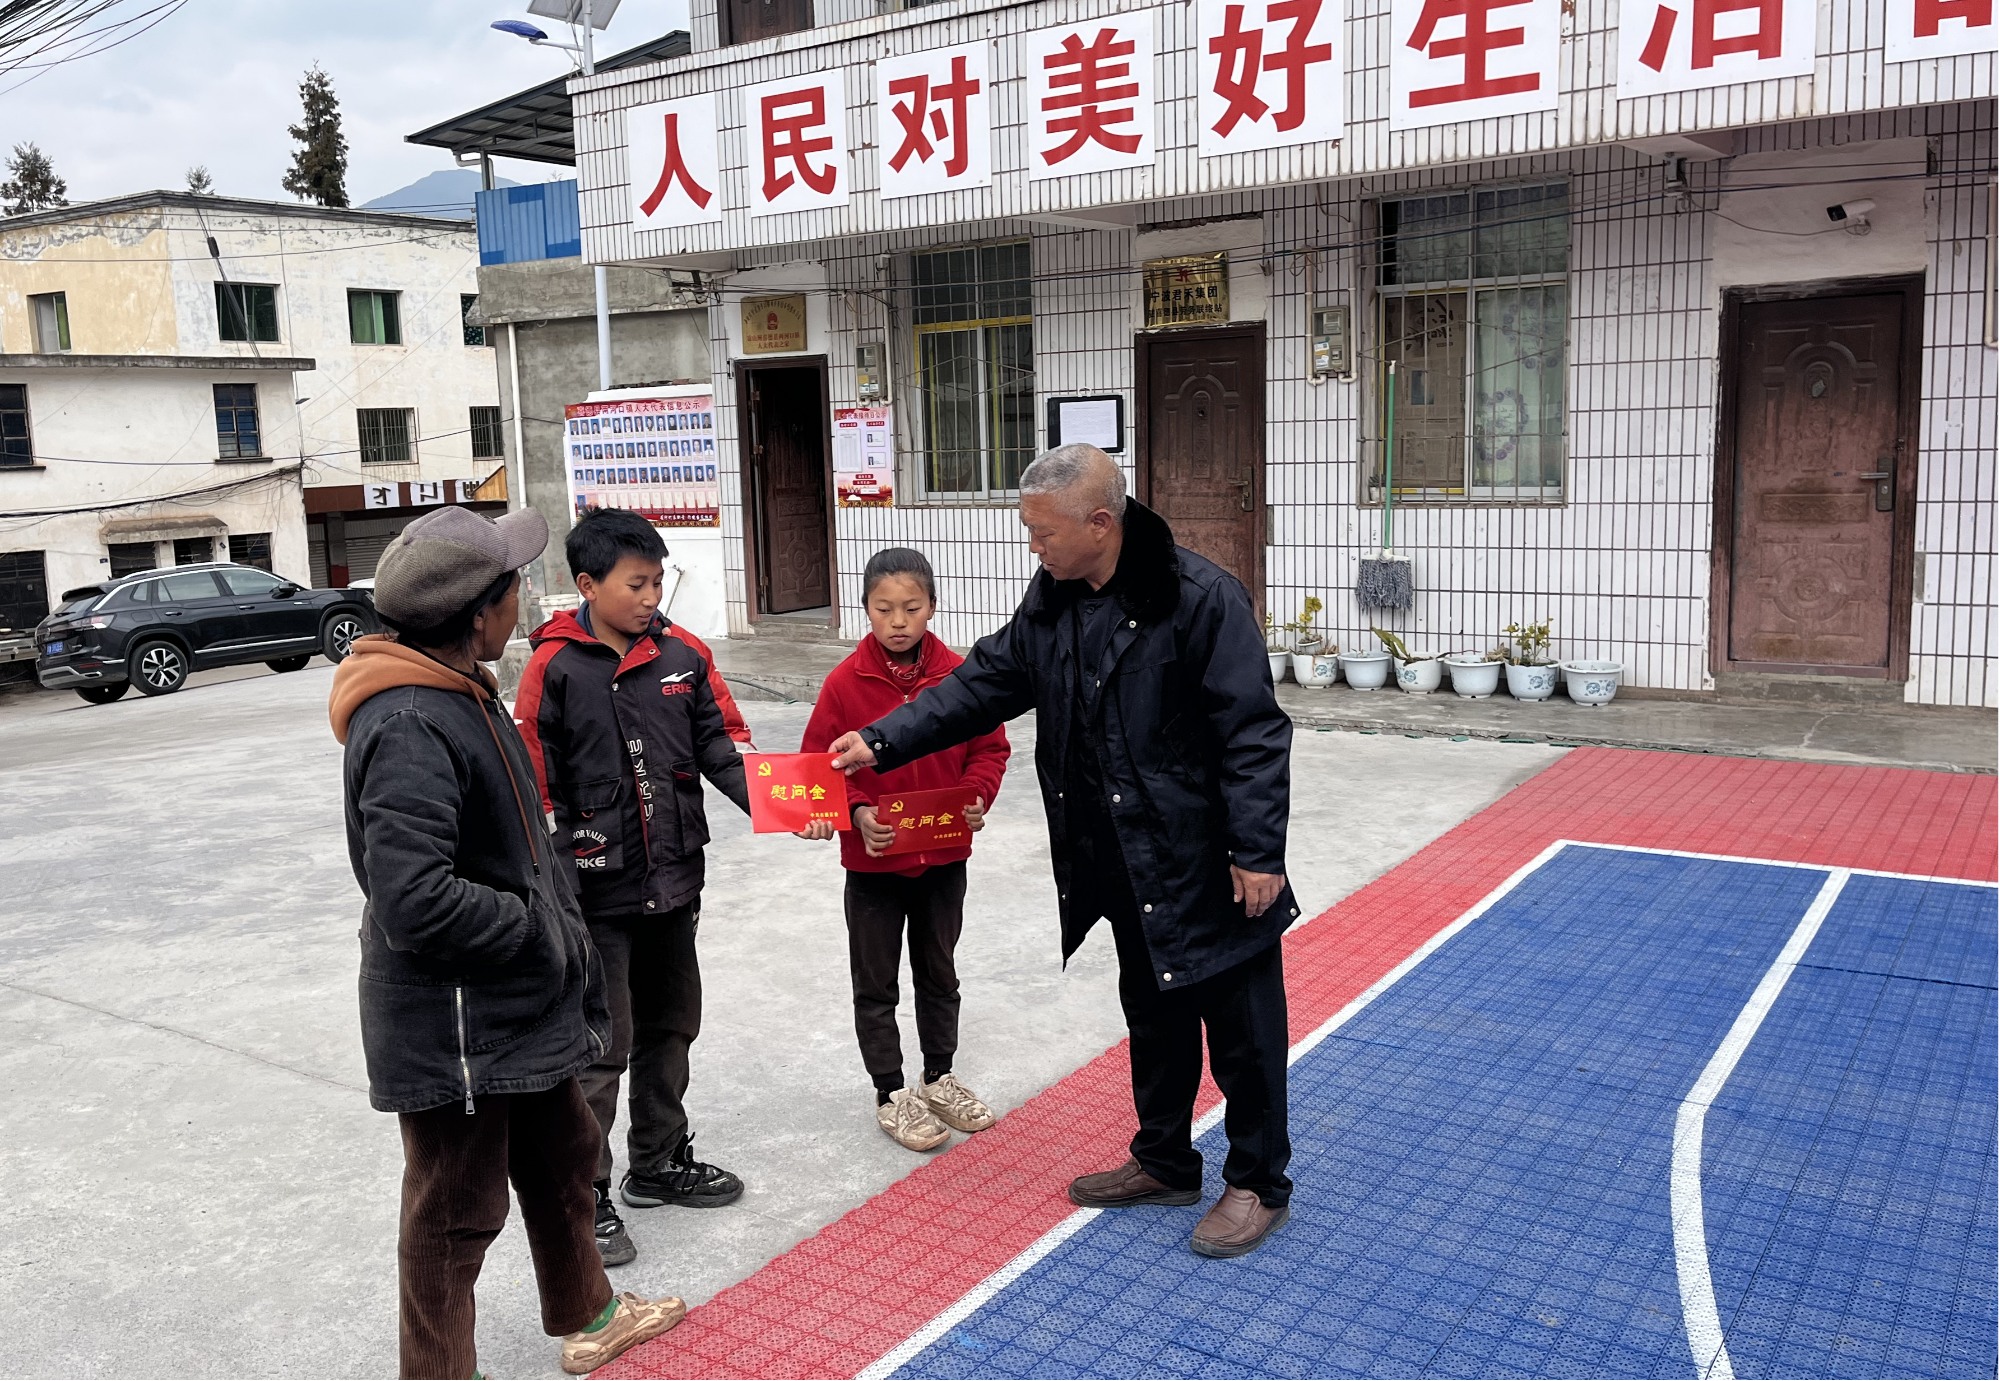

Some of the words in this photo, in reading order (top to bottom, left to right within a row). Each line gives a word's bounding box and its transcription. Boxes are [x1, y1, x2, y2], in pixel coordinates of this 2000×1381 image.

[639, 0, 1992, 218] 人民对美好生
[770, 783, 827, 801] 慰问金
[898, 812, 955, 830] 慰问金
[586, 829, 608, 844] VALUE
[575, 856, 606, 869] RKE
